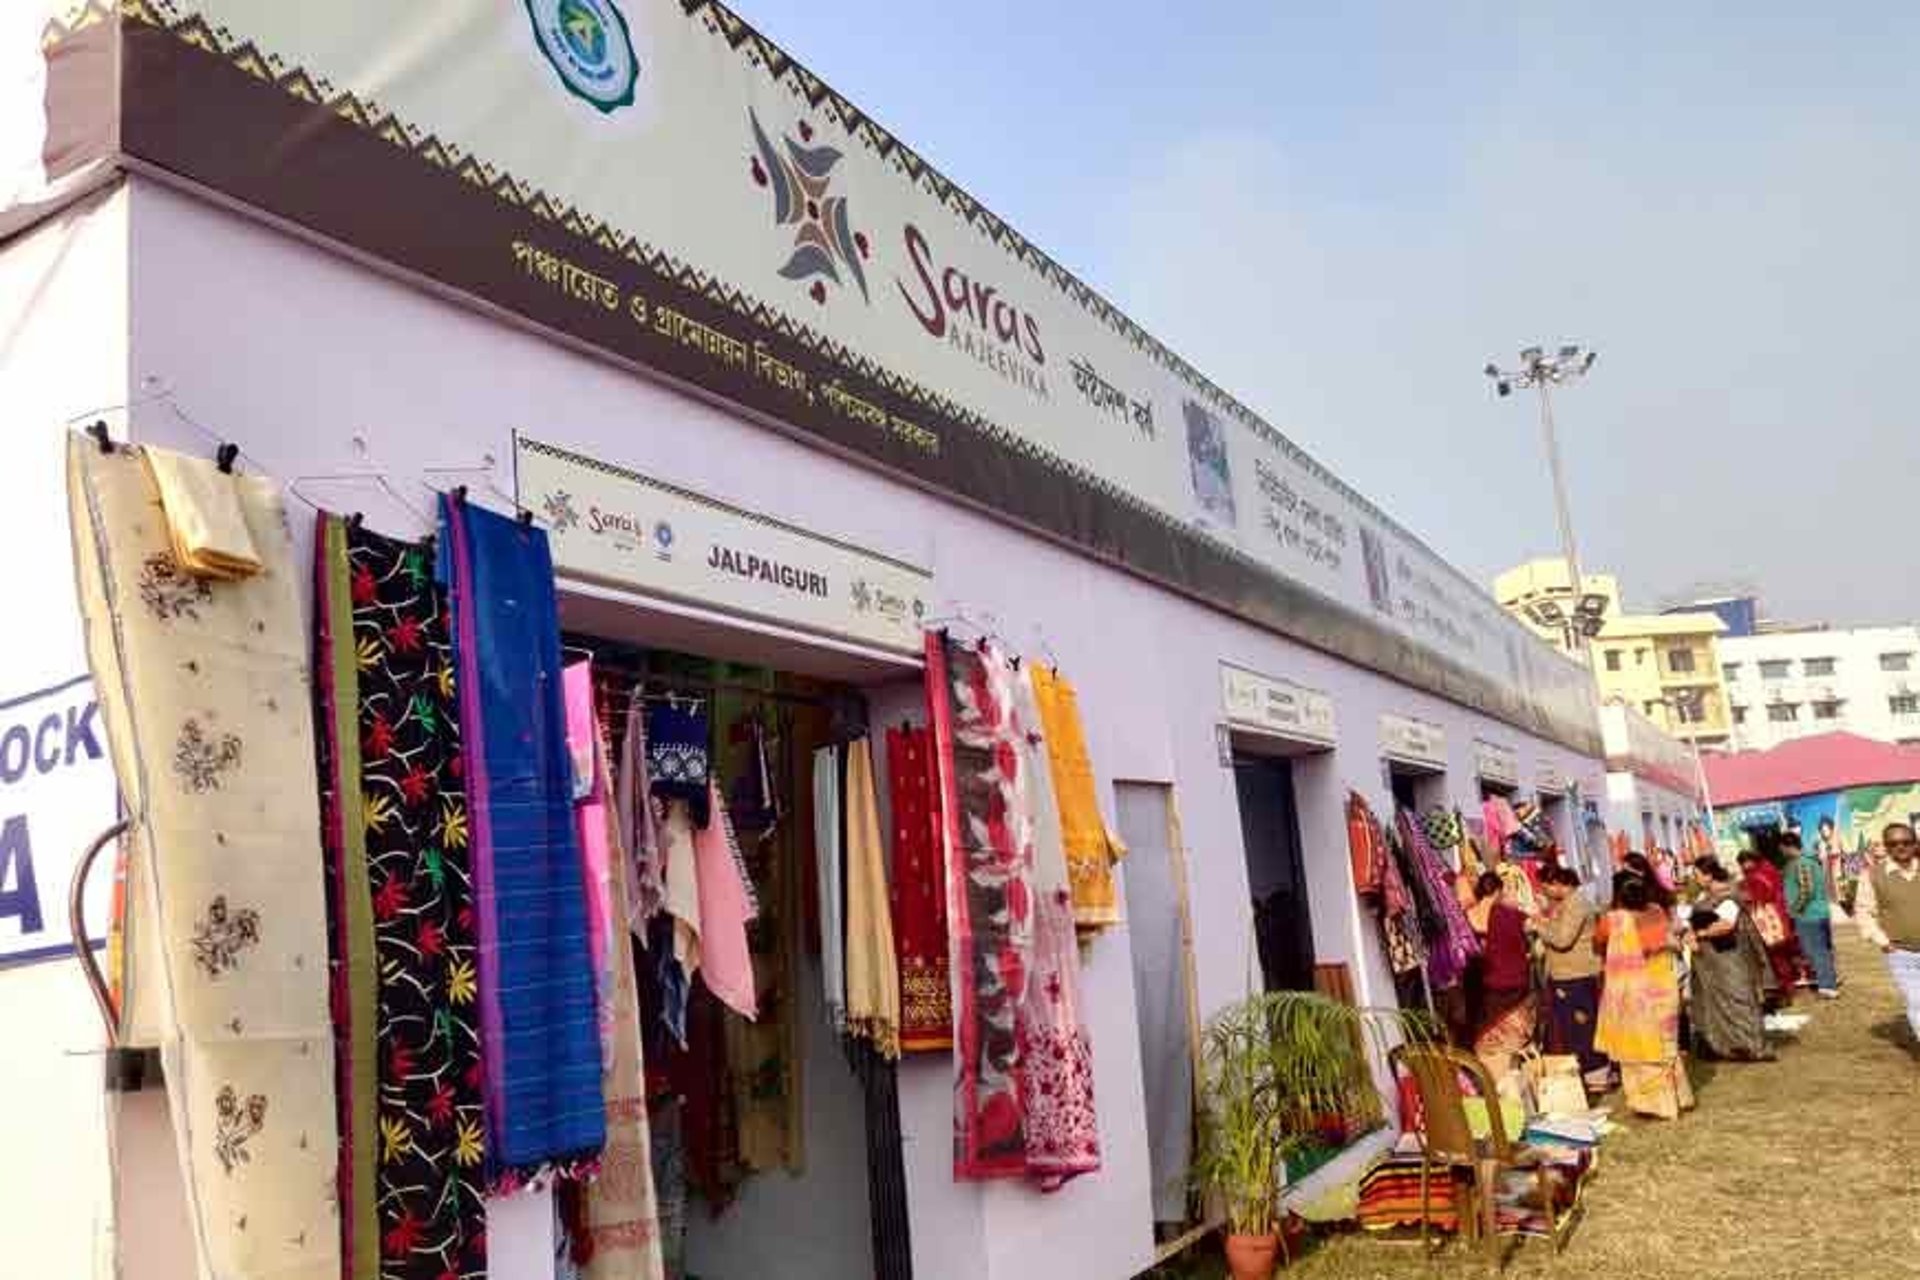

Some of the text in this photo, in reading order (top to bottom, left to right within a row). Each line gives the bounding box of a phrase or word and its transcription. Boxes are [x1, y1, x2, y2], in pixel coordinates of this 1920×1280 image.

[511, 240, 619, 311] পঞ্চায়েত
[630, 295, 648, 323] ও
[653, 305, 748, 373] গ্রামোন্নয়ন
[897, 223, 1045, 366] Saras
[949, 321, 1052, 403] AAJEEVIKA
[706, 545, 830, 598] JALPAIGURI
[0, 813, 44, 934] A
